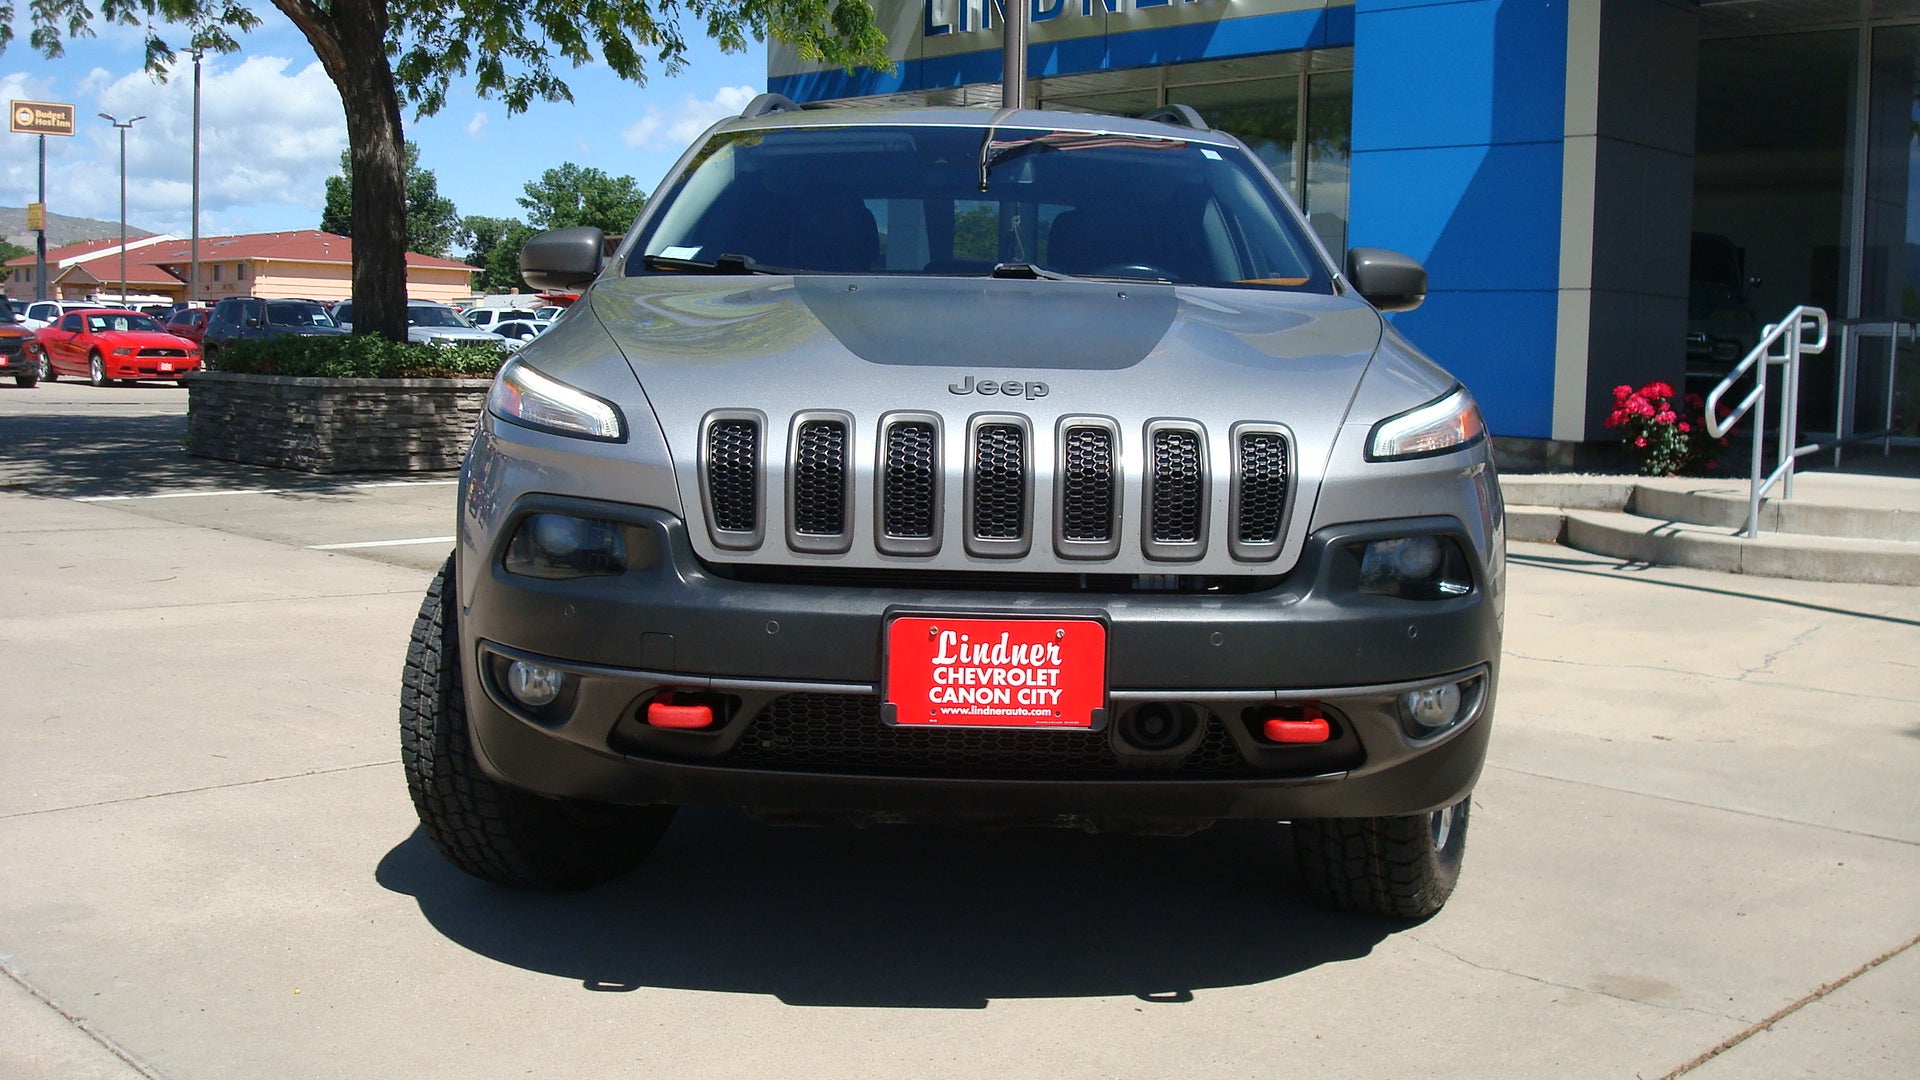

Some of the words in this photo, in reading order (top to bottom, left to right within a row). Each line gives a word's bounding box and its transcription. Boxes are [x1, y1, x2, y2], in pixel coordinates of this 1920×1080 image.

[924, 0, 1199, 36] LIND
[35, 109, 66, 120] Budget
[35, 118, 56, 127] Host
[56, 120, 71, 128] Inn
[948, 376, 1050, 400] Jeep
[931, 630, 1063, 666] Lindner
[933, 667, 1060, 687] CHEVROLET
[928, 687, 1011, 705] CANON
[1017, 688, 1063, 705] CITY
[940, 705, 1052, 717] www.lindnerauto.com
